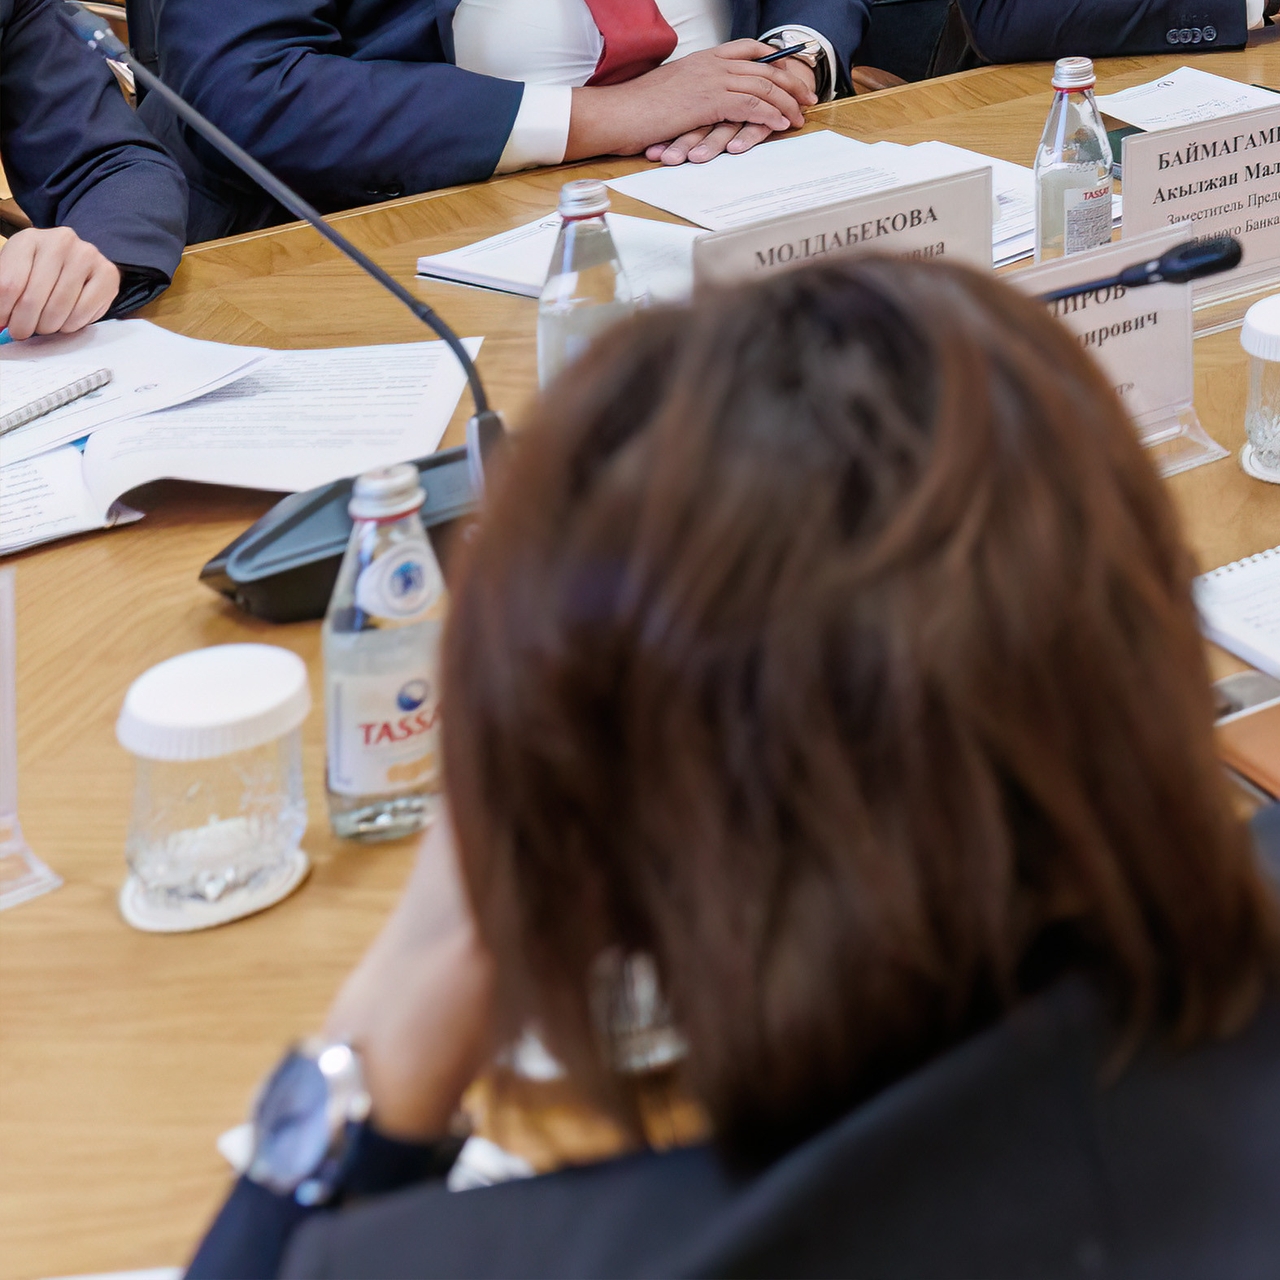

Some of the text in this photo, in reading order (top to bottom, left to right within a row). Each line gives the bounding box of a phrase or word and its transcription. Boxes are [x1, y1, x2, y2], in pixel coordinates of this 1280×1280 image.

[1152, 172, 1238, 205] Акылжан
[1166, 199, 1244, 226] Заместитель
[1245, 213, 1280, 233] Банка
[754, 205, 939, 270] МОЛДАБЕКОВА
